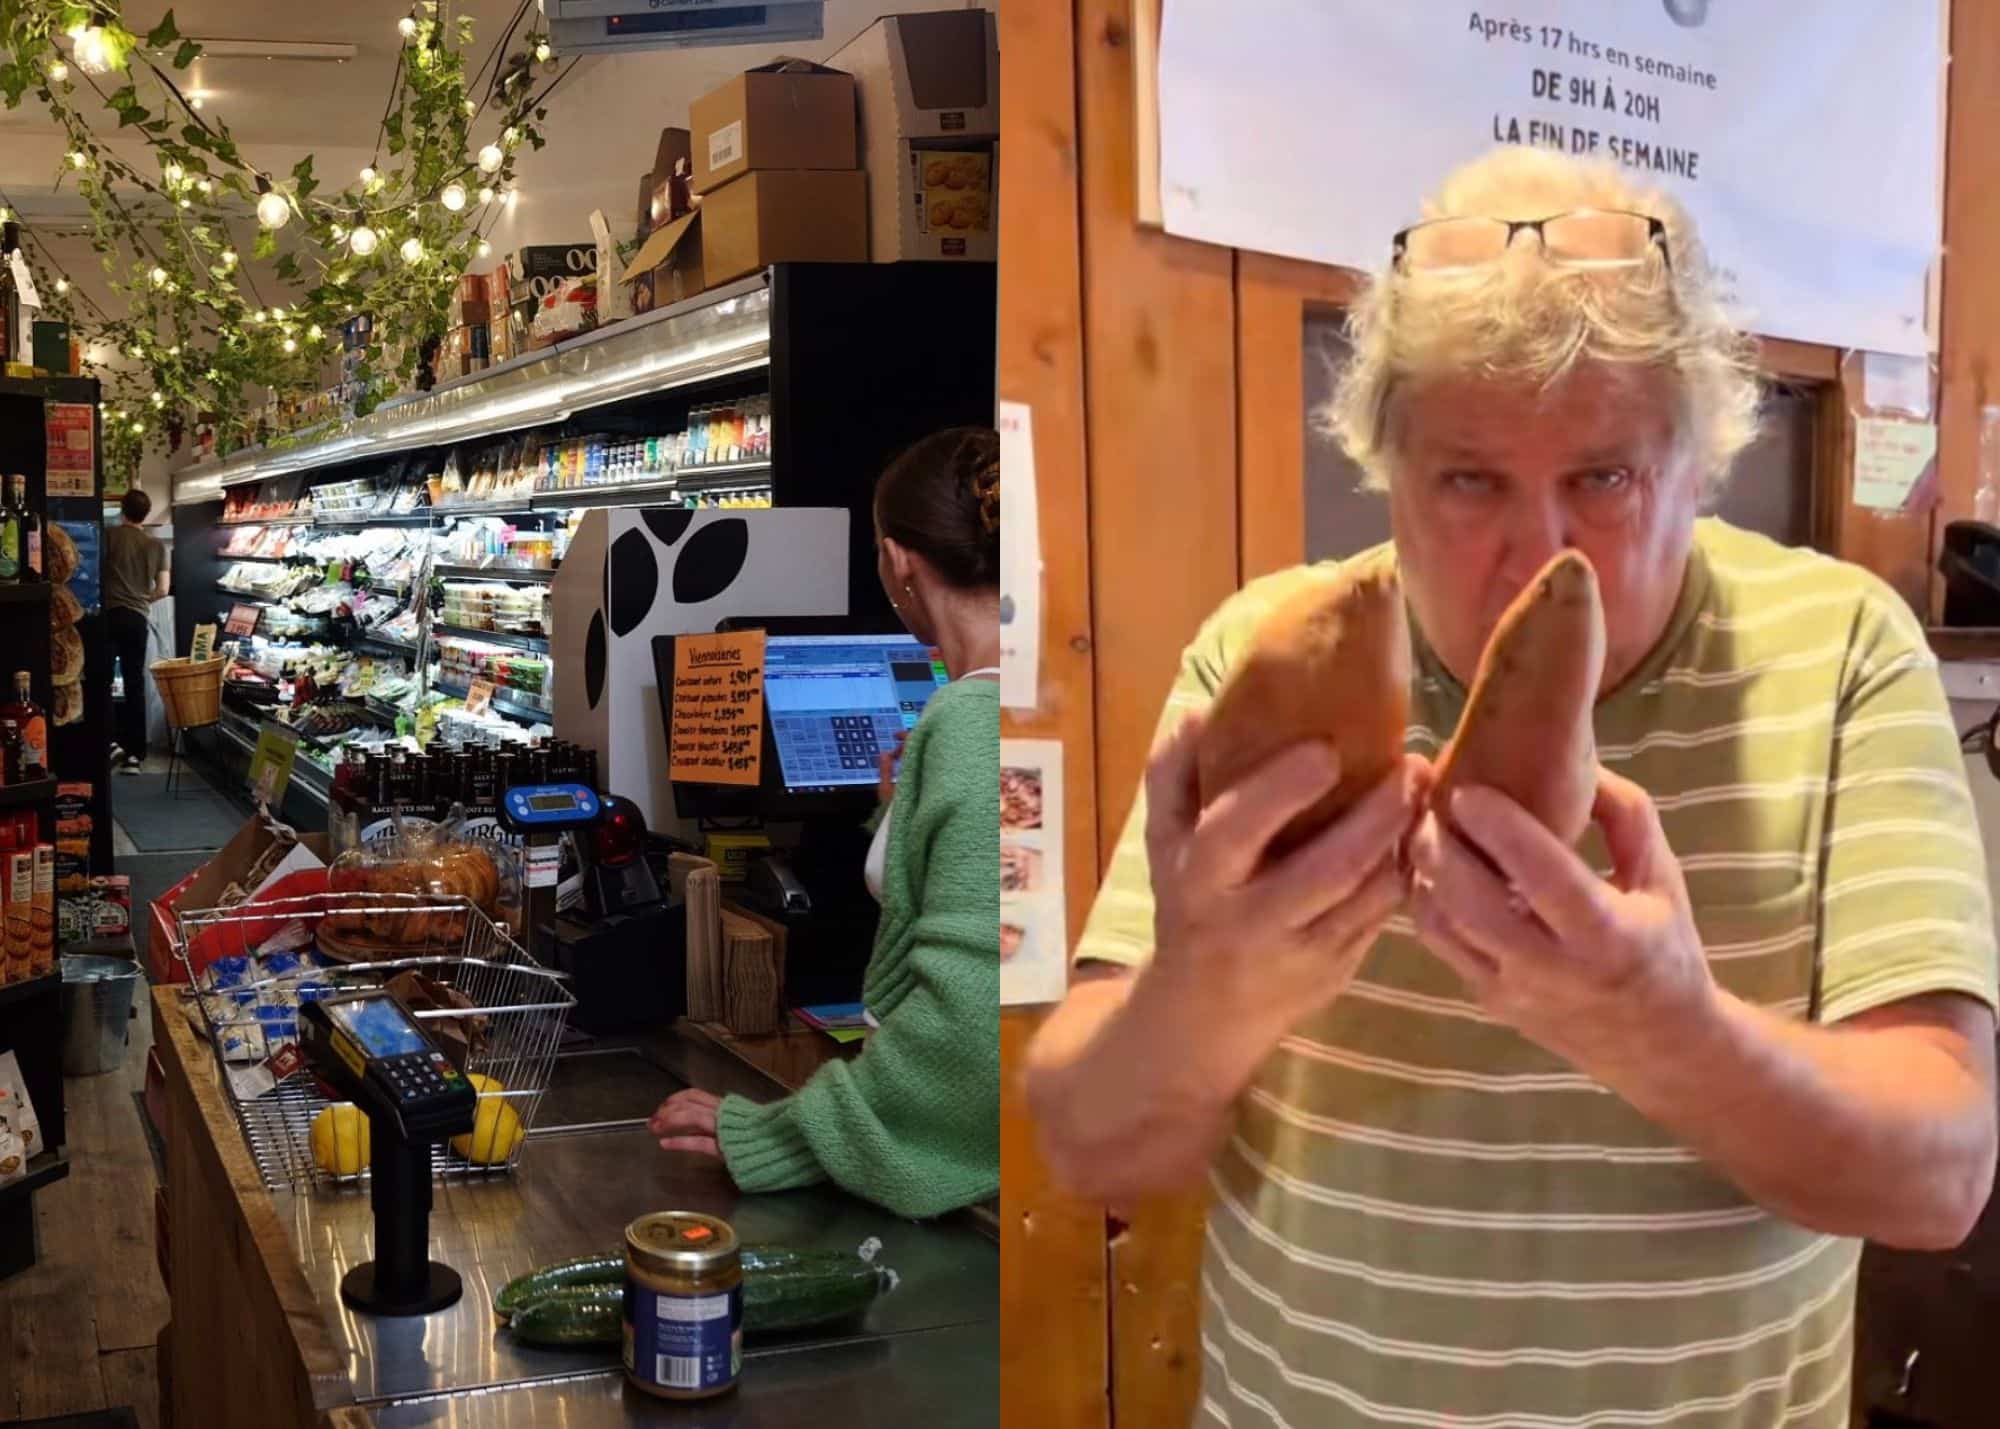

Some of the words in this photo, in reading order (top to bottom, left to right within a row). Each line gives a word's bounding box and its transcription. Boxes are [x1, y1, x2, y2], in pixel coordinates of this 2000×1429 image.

[1469, 12, 1532, 43] Après
[1540, 26, 1563, 49] 17
[1568, 31, 1601, 59] hrs
[1606, 48, 1630, 68] en
[1635, 55, 1718, 90] semaine
[1532, 69, 1562, 101] DE
[1569, 77, 1596, 107] 9H
[1603, 76, 1616, 112] À
[1624, 90, 1661, 123] 20H
[1493, 114, 1521, 145] LA
[1529, 121, 1564, 150] FIN
[1608, 136, 1700, 179] SEMAINE
